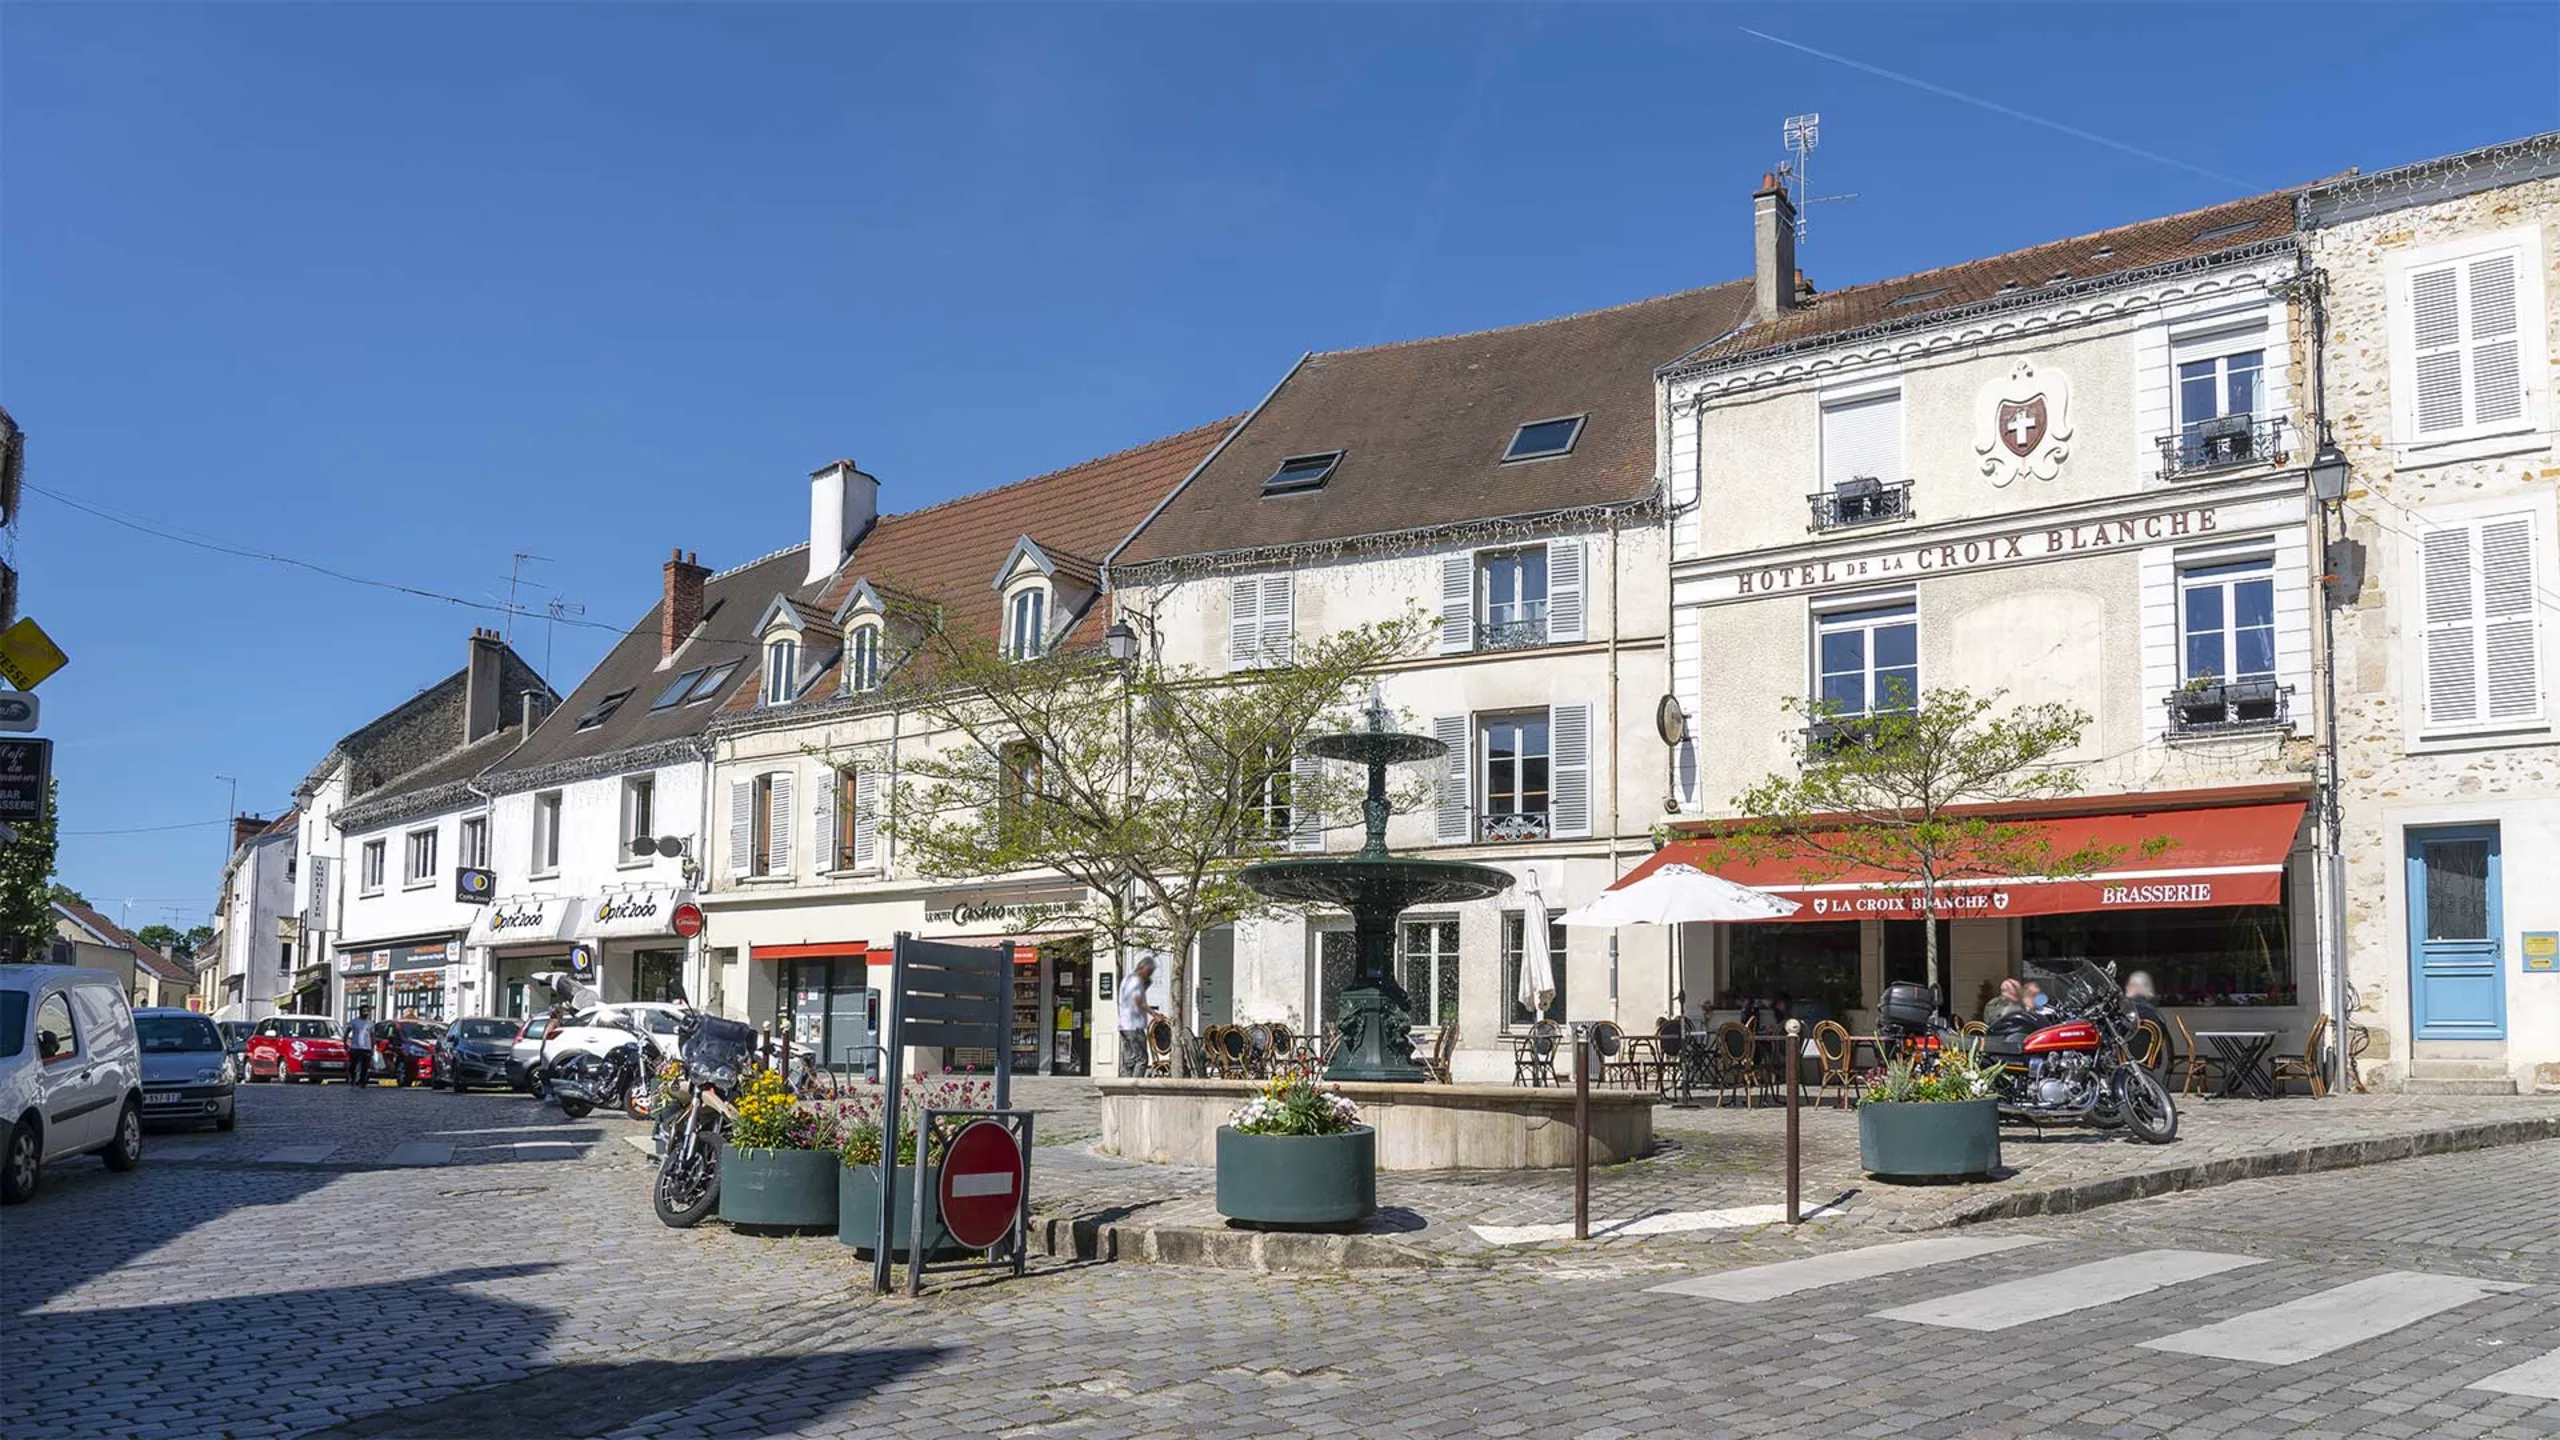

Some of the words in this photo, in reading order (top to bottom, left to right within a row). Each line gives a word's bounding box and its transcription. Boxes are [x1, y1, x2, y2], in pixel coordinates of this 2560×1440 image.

[1847, 563, 1867, 576] DE
[1882, 557, 1903, 571] LA
[1917, 535, 2023, 569] CROIX
[2047, 508, 2216, 552] BLANCHE
[314, 860, 324, 918] IMMOBILIER
[1832, 899, 1852, 912] LA
[1856, 898, 1905, 911] CROIX
[2102, 884, 2211, 904] BRASSERIE
[952, 900, 1005, 926] Casino
